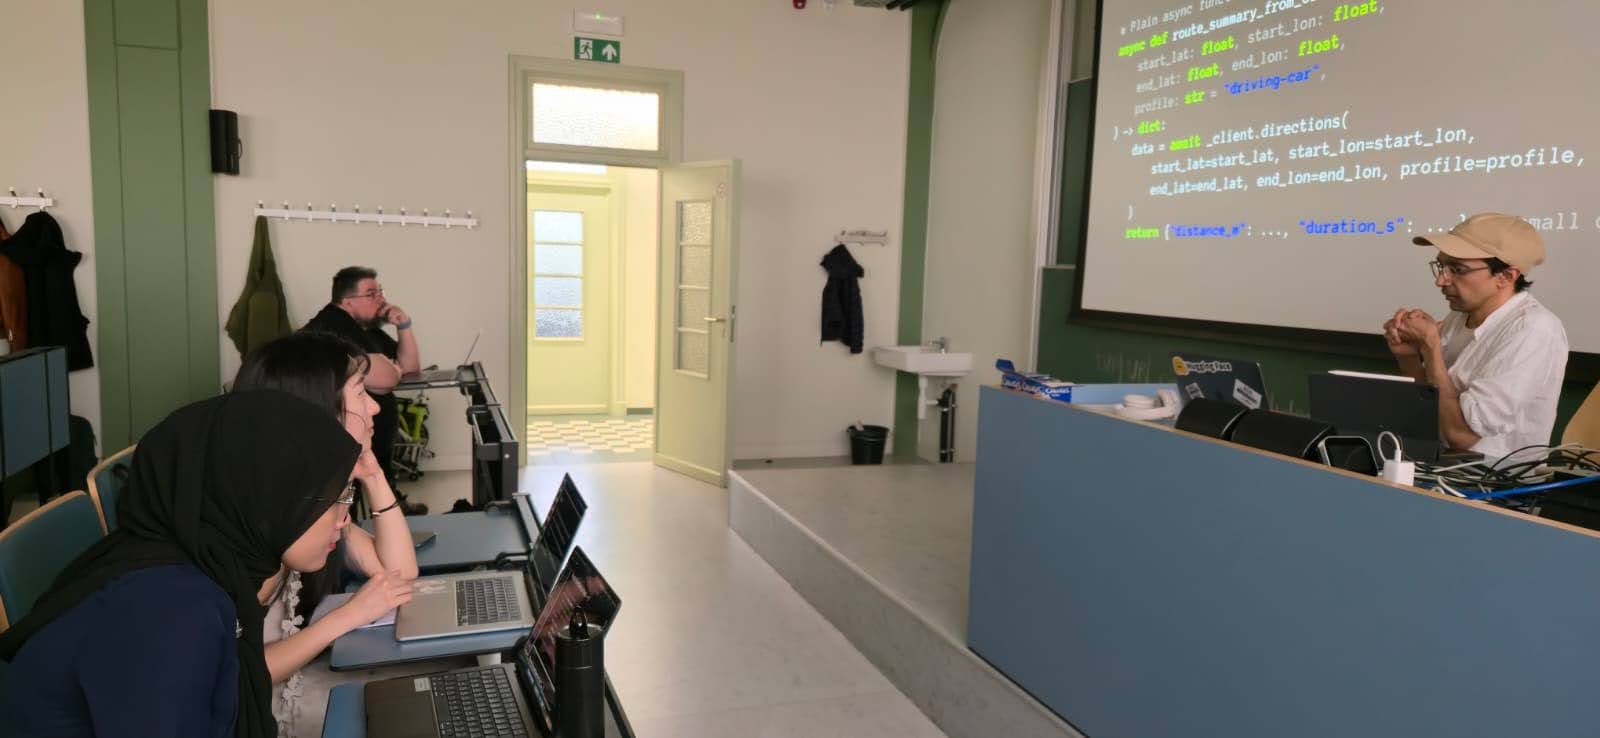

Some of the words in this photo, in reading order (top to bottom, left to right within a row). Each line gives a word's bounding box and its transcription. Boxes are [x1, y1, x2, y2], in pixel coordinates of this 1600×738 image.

[1130, 16, 1158, 32] Plain
[1163, 5, 1193, 22] async
[1200, 0, 1230, 10] func
[1137, 49, 1194, 71] start_lat:
[1201, 35, 1239, 56] float,
[1247, 15, 1323, 43] start_lon:
[1333, 0, 1384, 22] float,
[1149, 31, 1169, 47] def
[1136, 72, 1181, 93] end_lat:
[1187, 62, 1223, 82] float,
[1231, 49, 1288, 71] end_lon:
[1298, 34, 1345, 57] float,
[1135, 96, 1179, 115] profile:
[1184, 89, 1205, 104] str
[1131, 143, 1155, 156] data
[1169, 134, 1201, 151] await
[1206, 111, 1349, 147] _client.directions(
[1136, 120, 1166, 135] dict:
[1151, 149, 1280, 175] start_lat=start_lat,
[1288, 127, 1475, 160] start_lon=start_lon,
[1150, 177, 1249, 196] end_lat=end_lat,
[1256, 165, 1388, 188] end_lon=end_lon,
[1400, 147, 1585, 179] profile=profile,
[1125, 226, 1160, 239] return
[1299, 217, 1413, 236] "duration_s":
[1523, 212, 1579, 231] mall
